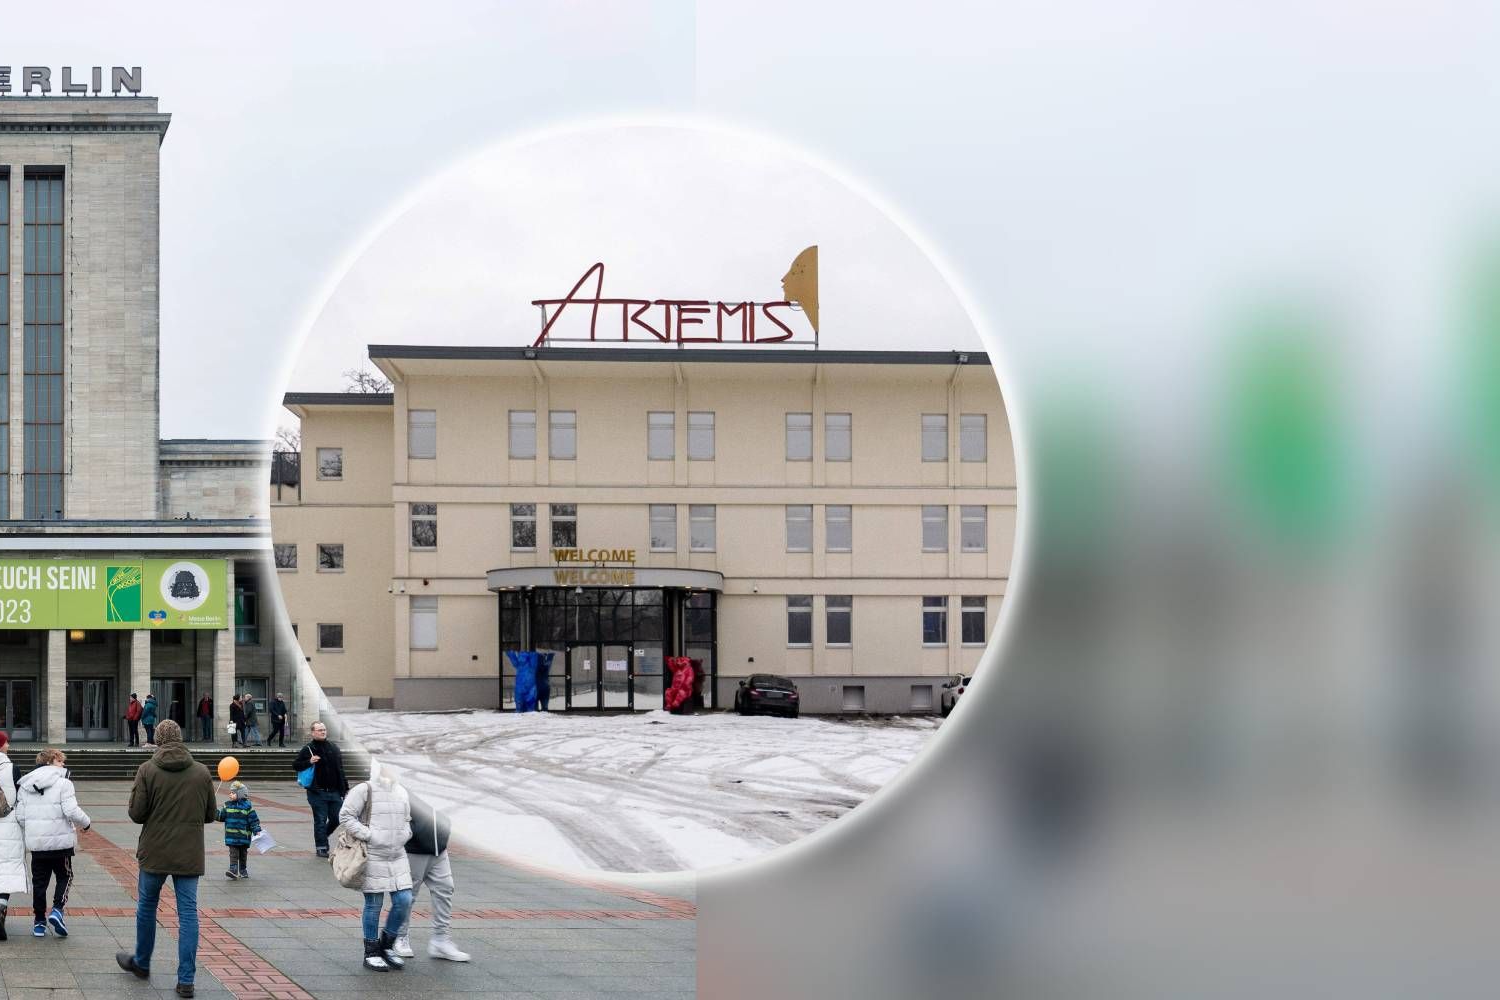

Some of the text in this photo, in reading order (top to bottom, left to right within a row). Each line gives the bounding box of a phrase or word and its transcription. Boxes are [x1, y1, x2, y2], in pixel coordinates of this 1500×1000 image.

[532, 262, 794, 347] ARTEMIS
[553, 549, 636, 562] WELCOME
[46, 566, 97, 590] SEIN!
[553, 570, 636, 584] WELCOME
